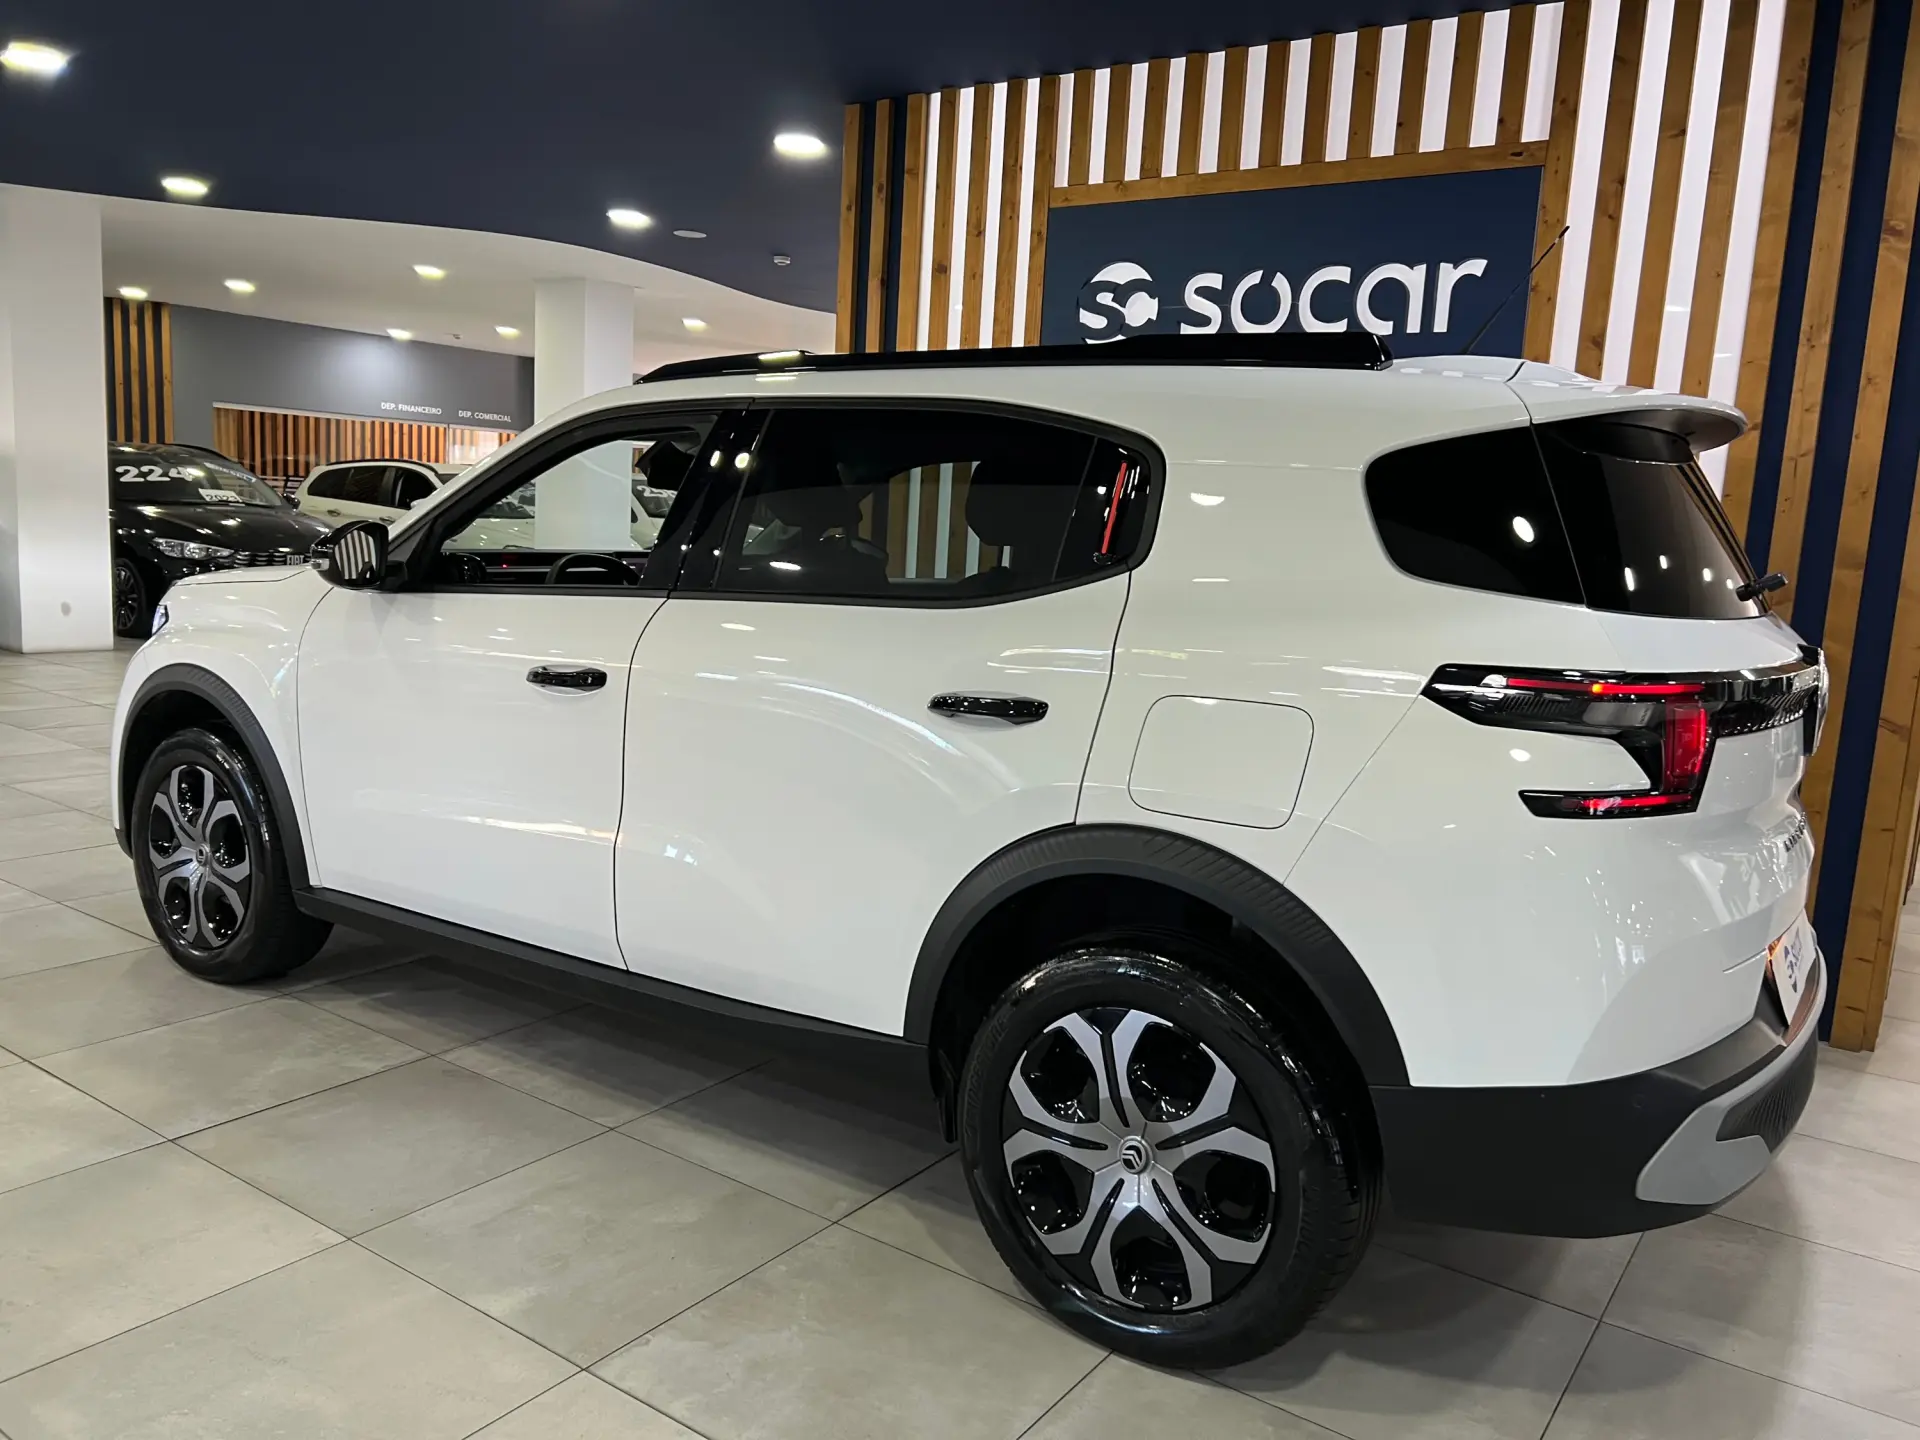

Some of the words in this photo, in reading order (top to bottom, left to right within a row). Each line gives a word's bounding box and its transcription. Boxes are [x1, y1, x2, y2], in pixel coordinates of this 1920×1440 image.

[1180, 258, 1488, 335] socar
[381, 402, 397, 411] DEP.
[398, 404, 442, 415] FINANCEIRO
[458, 410, 473, 419] DEP.
[474, 412, 512, 422] COMERCIAL
[287, 554, 305, 566] FIAT
